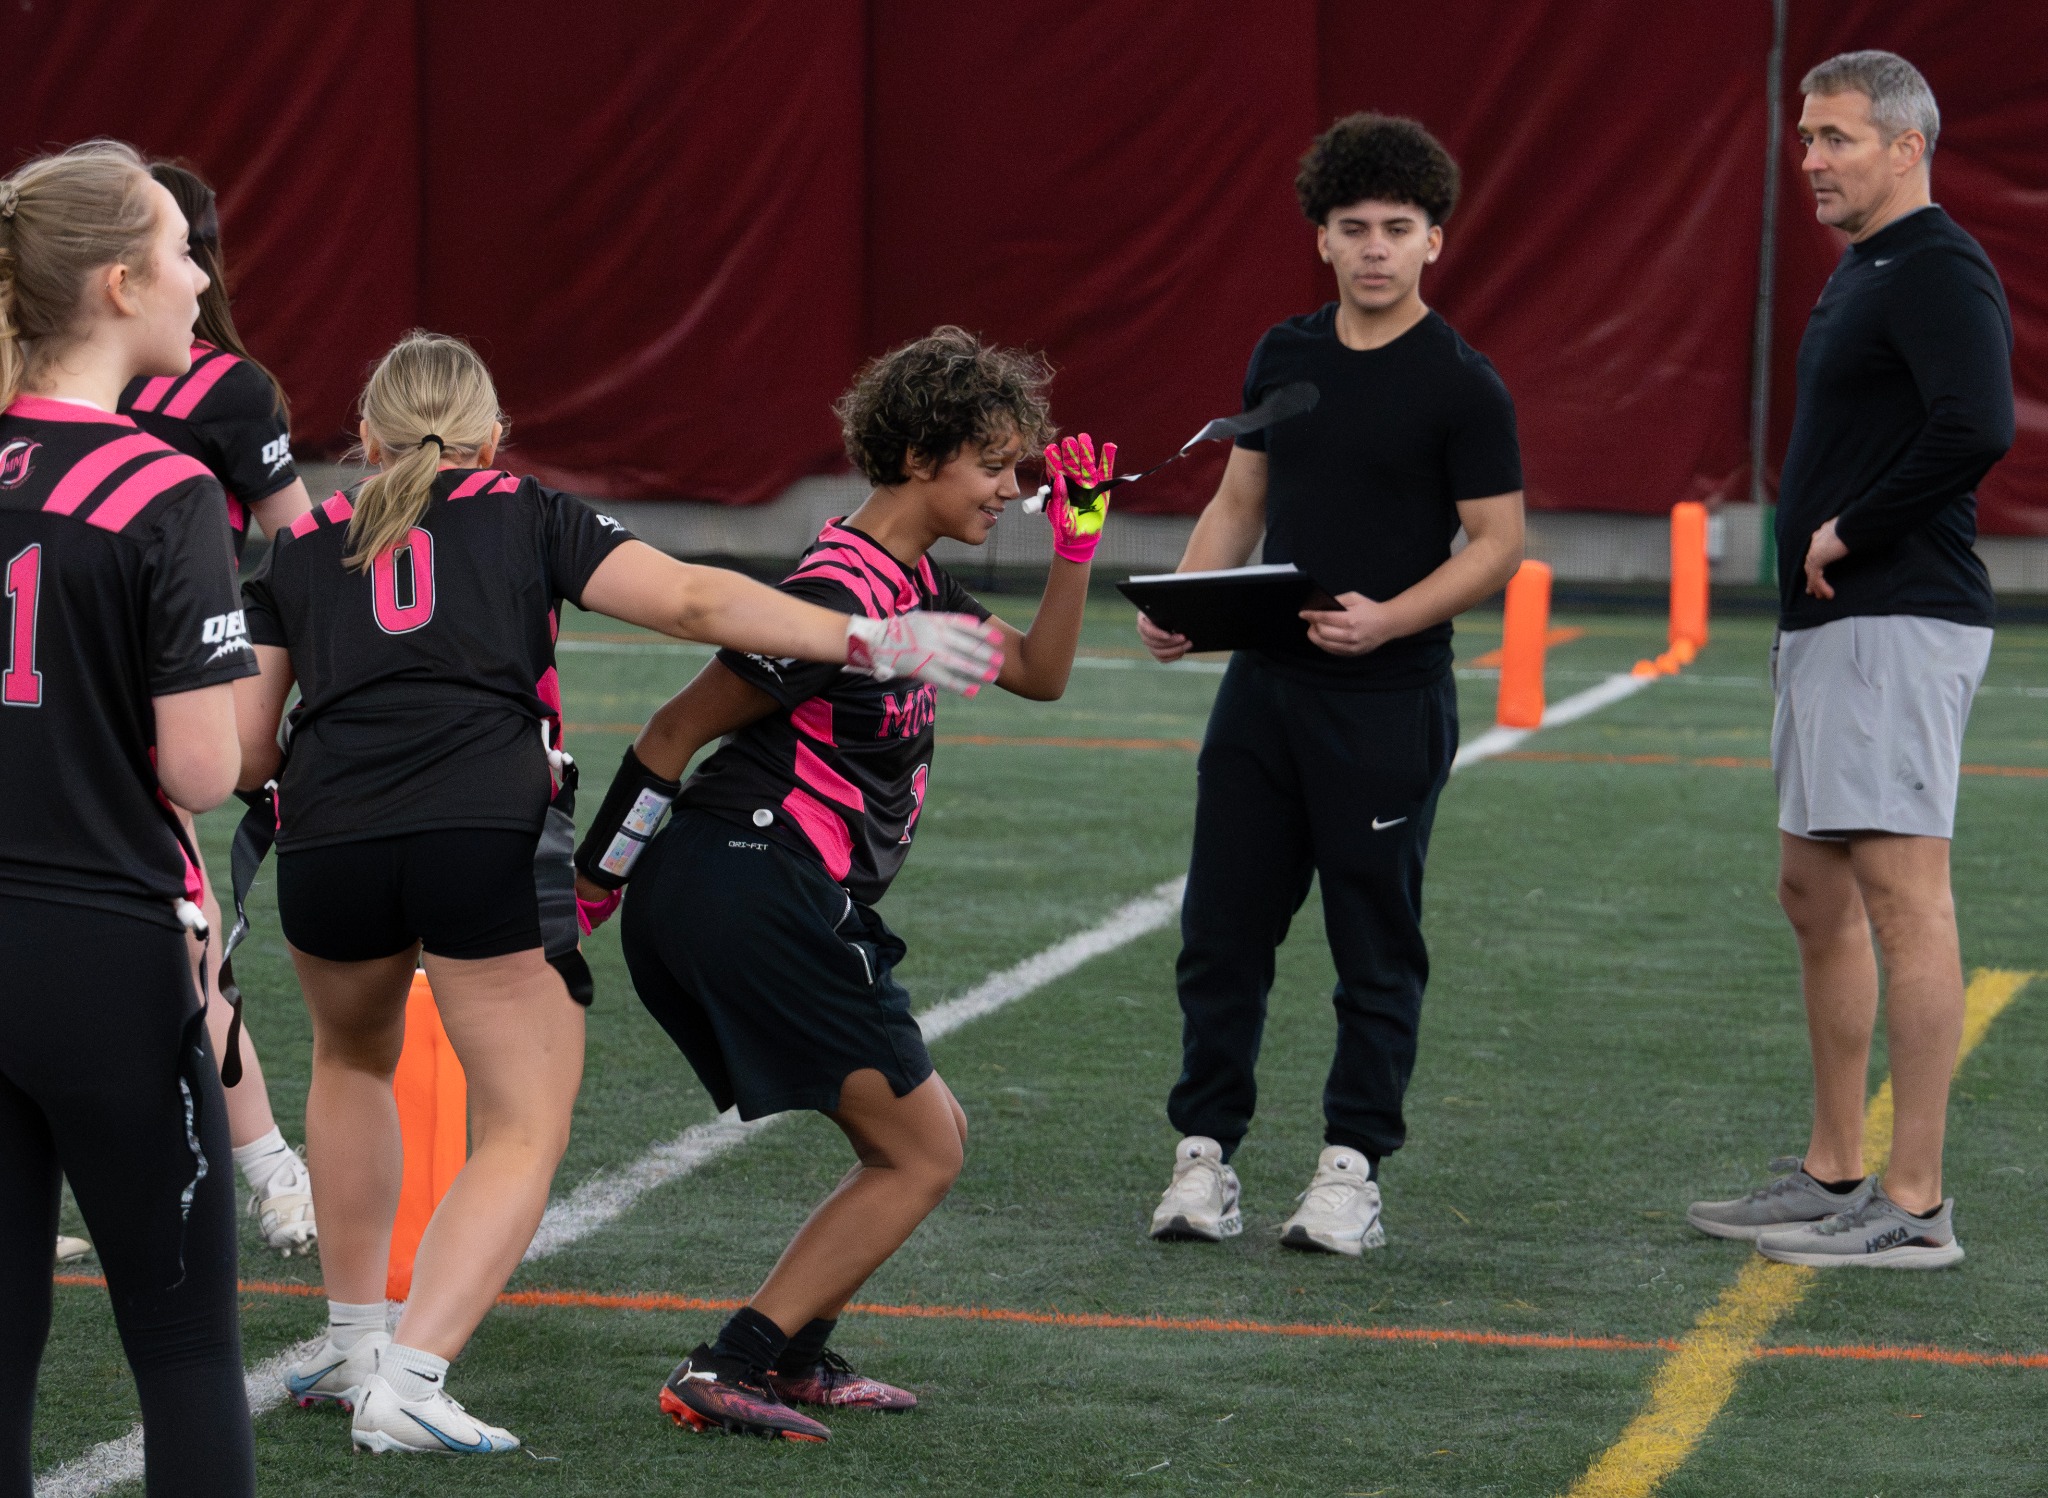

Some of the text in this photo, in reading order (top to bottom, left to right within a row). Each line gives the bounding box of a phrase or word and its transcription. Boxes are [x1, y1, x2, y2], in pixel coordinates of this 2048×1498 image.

[371, 526, 436, 635] 0
[3, 543, 42, 708] 1
[728, 840, 769, 851] DRI-FIT
[1865, 1226, 1909, 1254] HOKA
